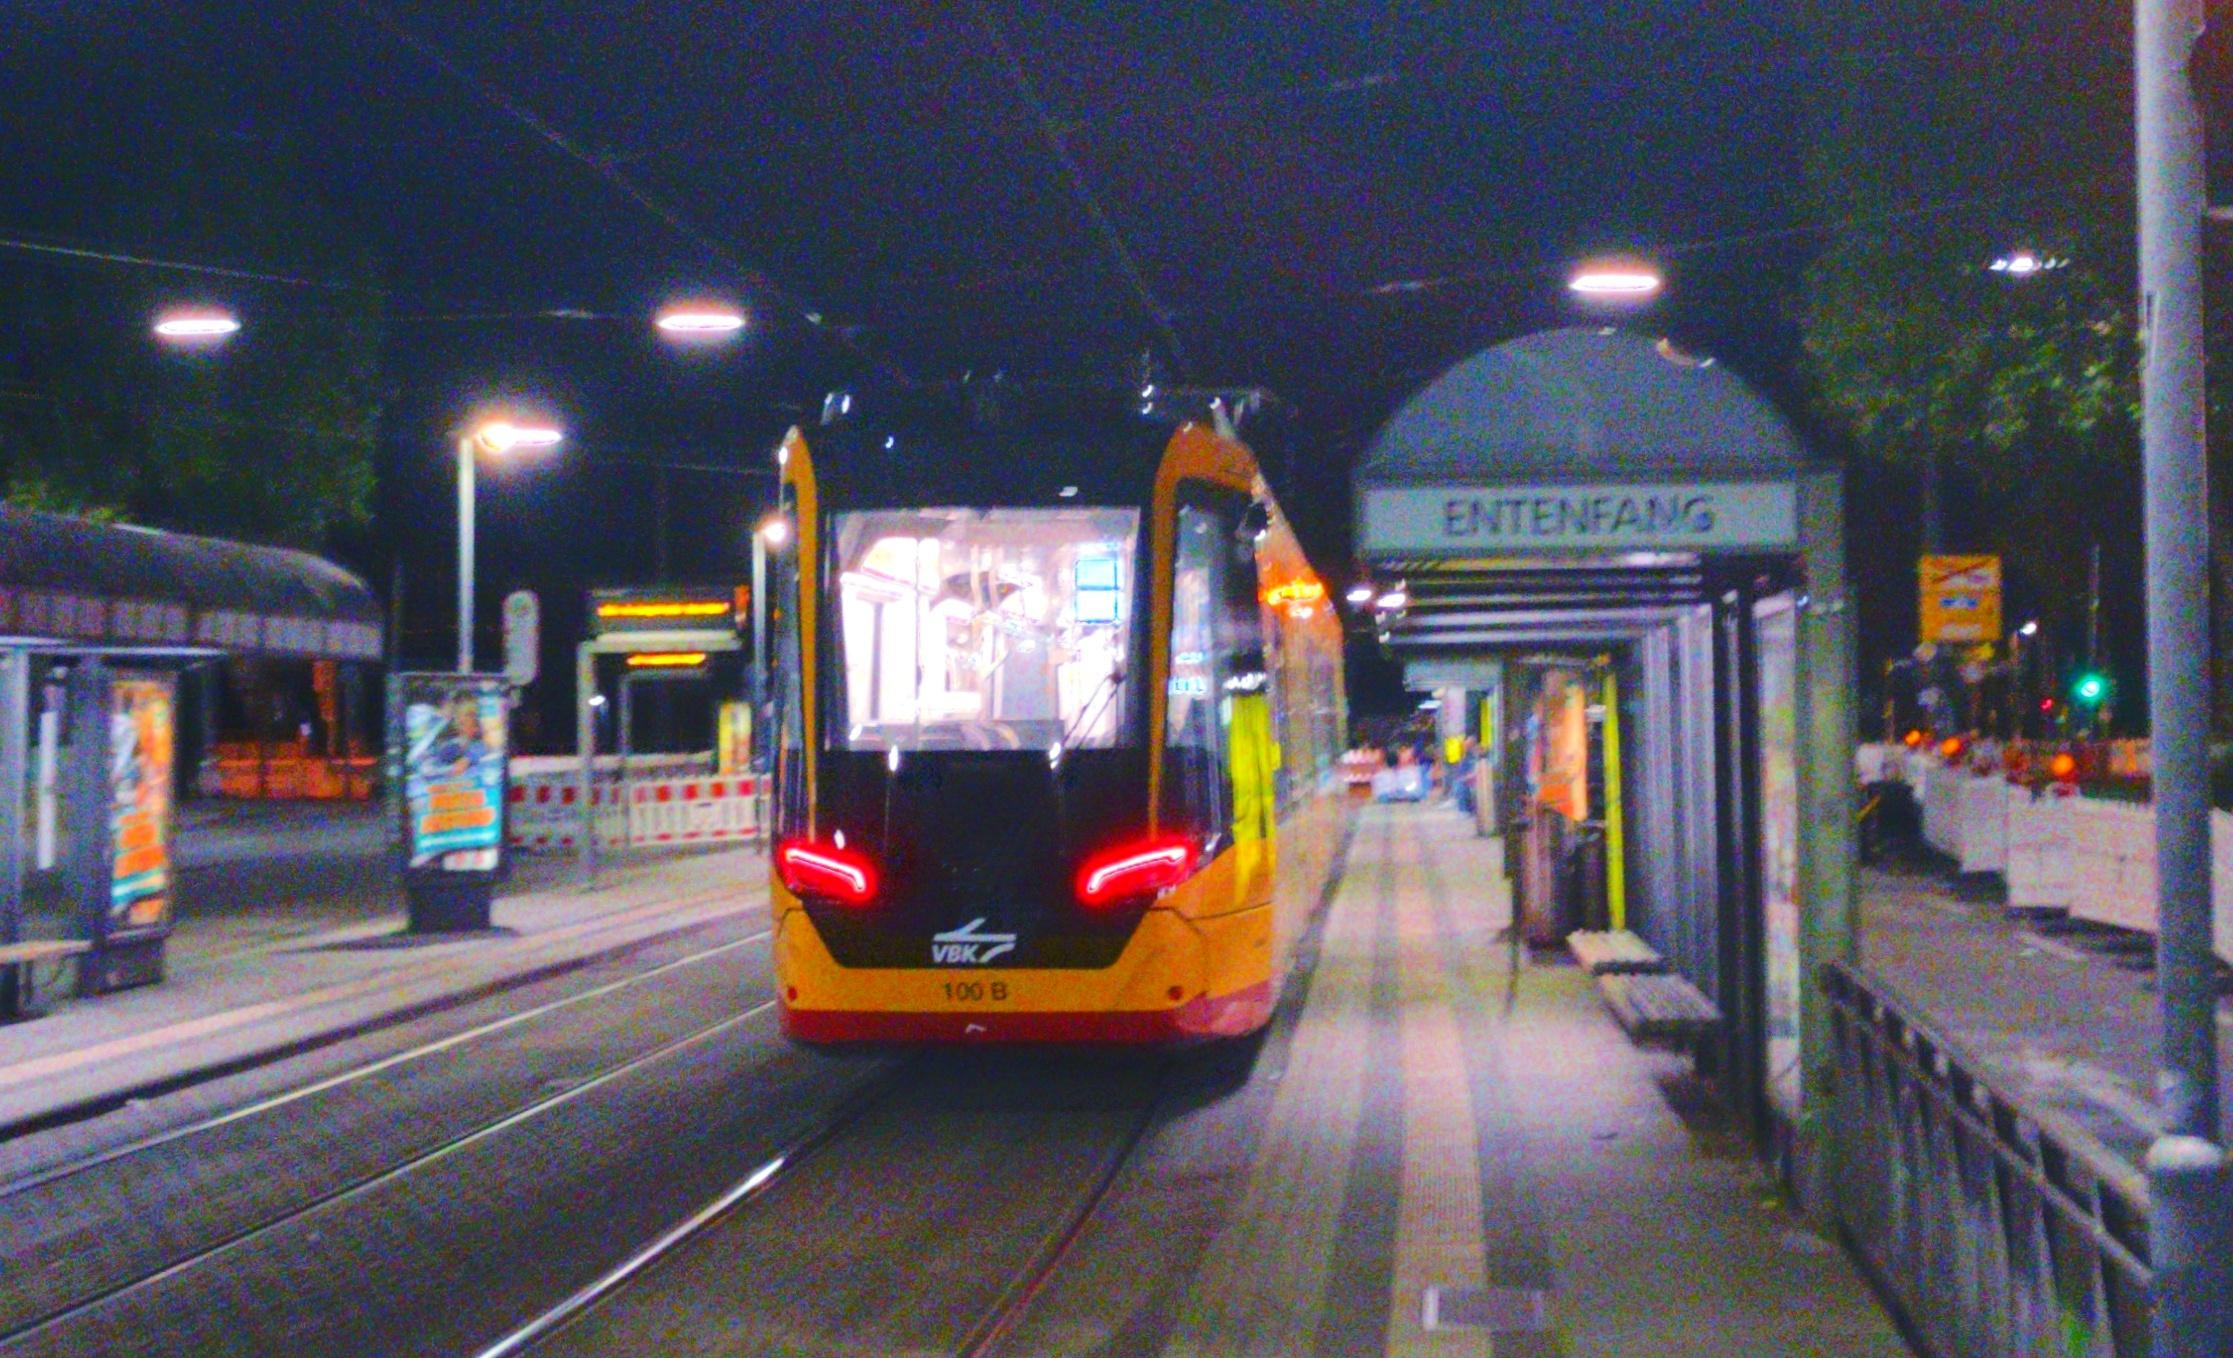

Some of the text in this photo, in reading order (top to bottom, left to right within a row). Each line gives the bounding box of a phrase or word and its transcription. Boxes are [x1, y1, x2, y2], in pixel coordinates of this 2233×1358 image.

[1443, 494, 1715, 536] ENTENFANG
[932, 943, 979, 963] VBK
[944, 981, 1008, 1001] 100 B
